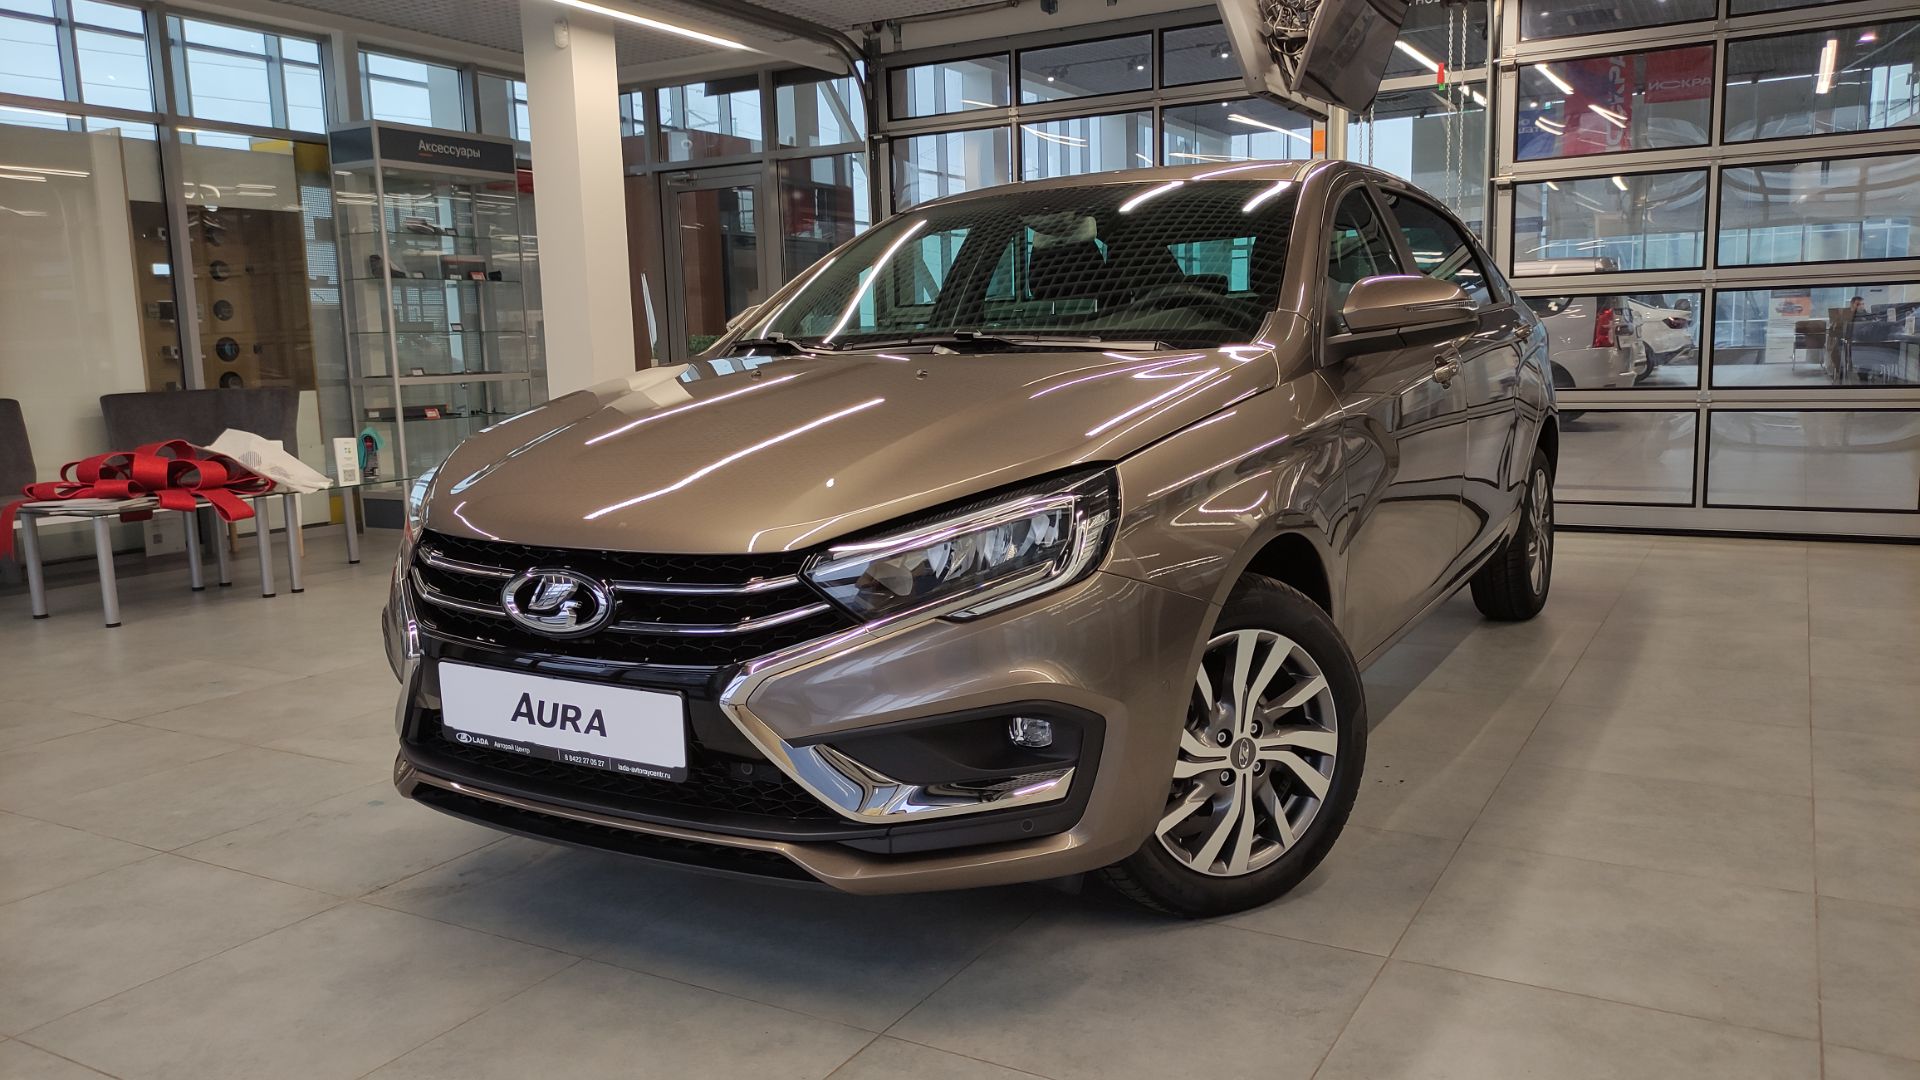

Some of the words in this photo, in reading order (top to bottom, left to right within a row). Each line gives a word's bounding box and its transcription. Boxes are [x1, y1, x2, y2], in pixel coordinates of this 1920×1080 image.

[1648, 77, 1712, 91] ИСКРА
[418, 139, 480, 158] Аксессуары
[510, 692, 607, 737] AURA
[472, 737, 489, 746] LADA
[494, 741, 515, 751] Авторай
[515, 745, 531, 755] Центр
